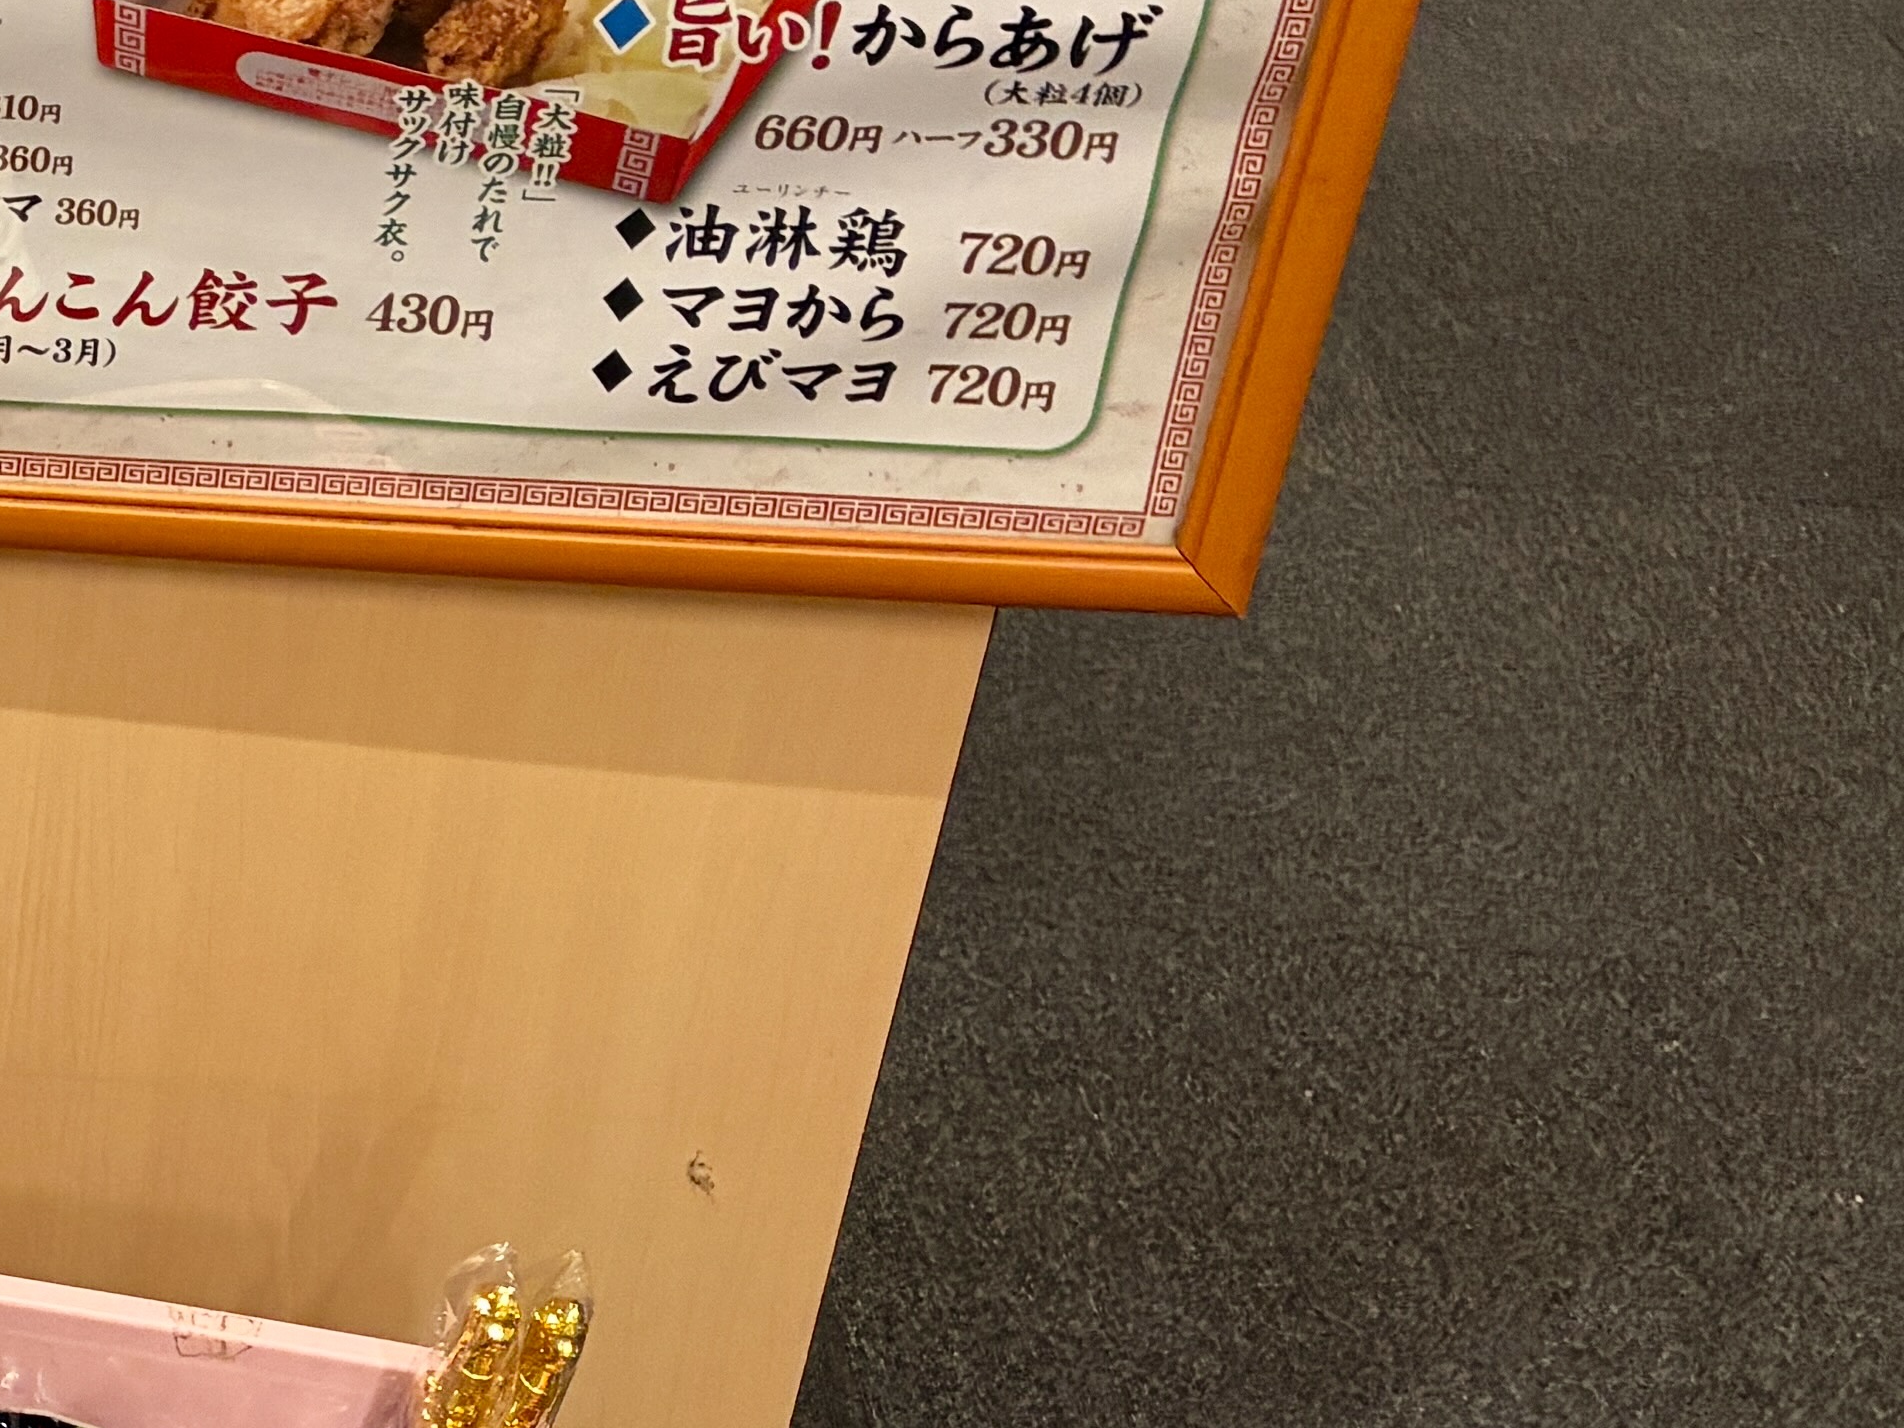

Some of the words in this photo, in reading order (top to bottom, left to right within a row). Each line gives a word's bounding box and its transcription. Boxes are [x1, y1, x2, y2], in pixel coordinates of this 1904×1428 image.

[437, 82, 480, 165] 味付け
[753, 114, 883, 153] 660円
[373, 88, 433, 263] サックサク衣。
[470, 95, 525, 263] 自慢のたれで
[55, 195, 140, 231] 360円
[664, 204, 907, 278] 油淋鶏
[959, 231, 1092, 280] 720円
[365, 292, 495, 341] 430円
[661, 284, 905, 341] マヨから
[943, 301, 1072, 345] 720円
[647, 344, 899, 405] えびマヨ
[926, 363, 1057, 413] 720円
